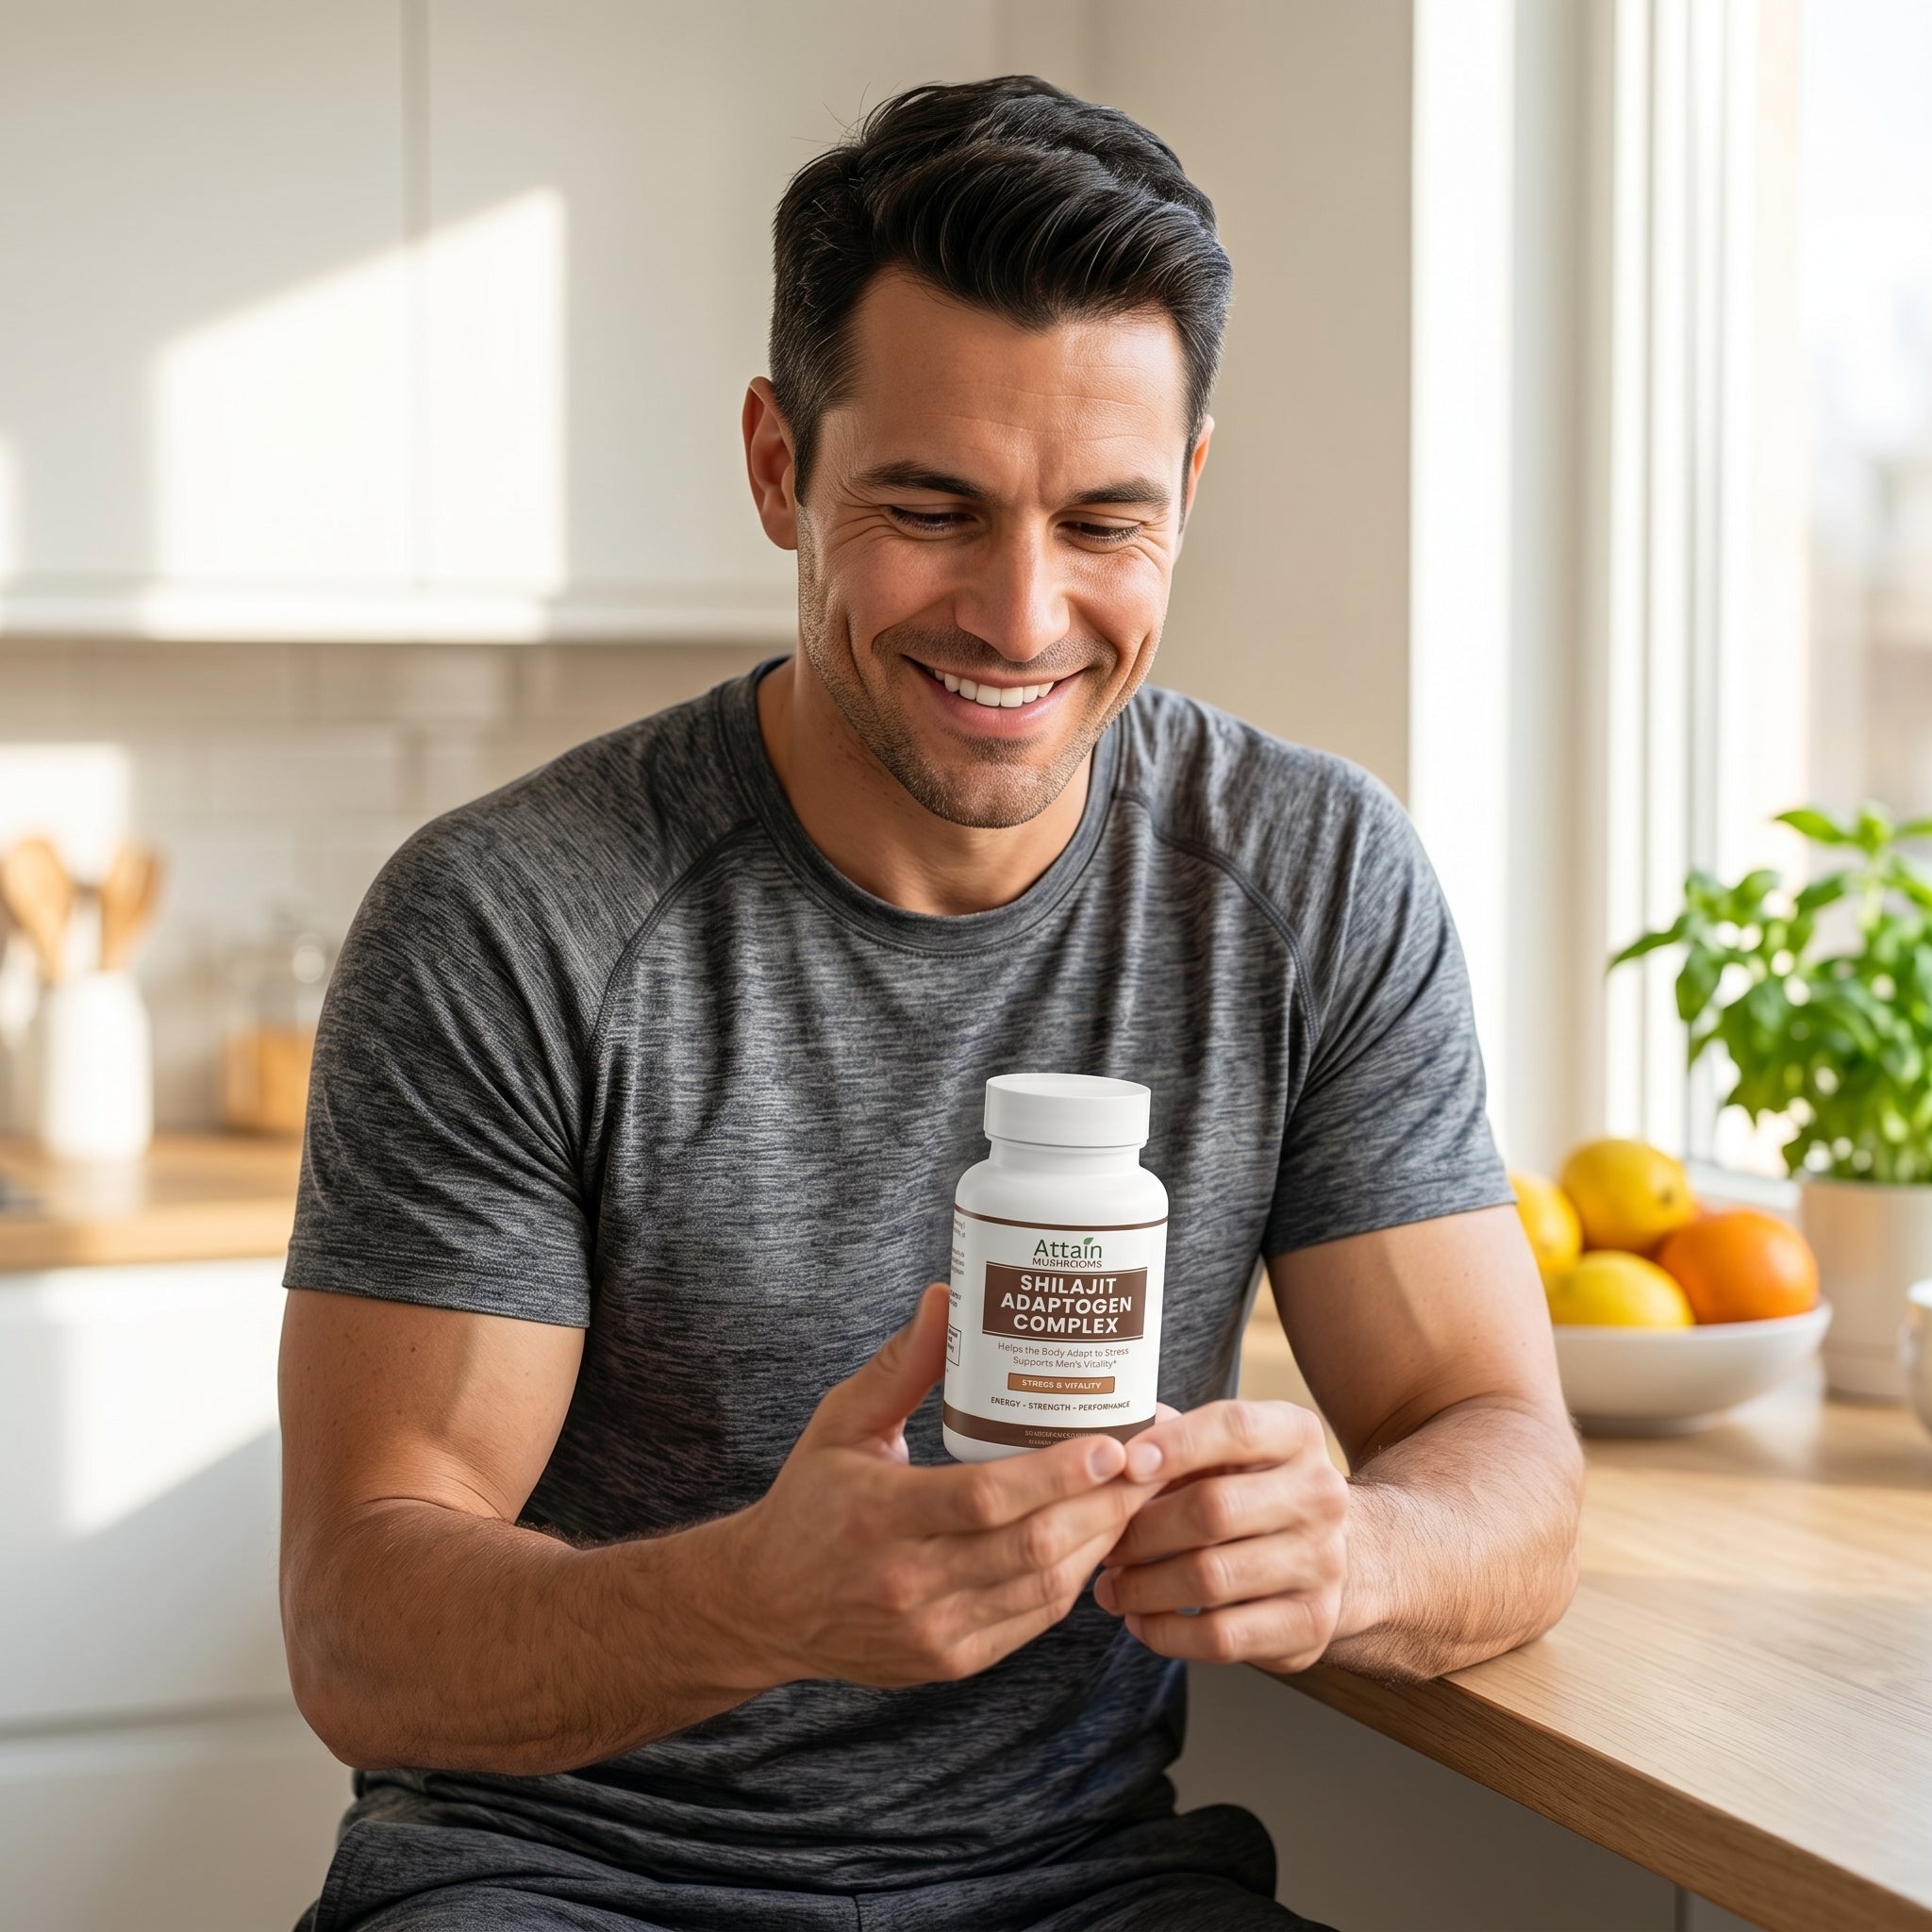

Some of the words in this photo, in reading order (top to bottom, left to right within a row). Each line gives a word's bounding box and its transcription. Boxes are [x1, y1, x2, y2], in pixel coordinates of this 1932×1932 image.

[1034, 1238, 1102, 1258] Attain
[1021, 1274, 1117, 1294] SHILAJIT
[1000, 1292, 1132, 1314] ADAPTOGEN
[1013, 1314, 1119, 1334] COMPLEX
[998, 1342, 1024, 1354] Helps
[1024, 1346, 1040, 1355] the
[1041, 1347, 1065, 1358] Body
[1067, 1349, 1092, 1358] Adapt
[1105, 1348, 1129, 1357] Stress
[1013, 1356, 1054, 1367] Supports
[1056, 1359, 1082, 1368] Men's
[991, 1396, 1021, 1407] ENERGY
[1028, 1402, 1071, 1411] STRENGTH
